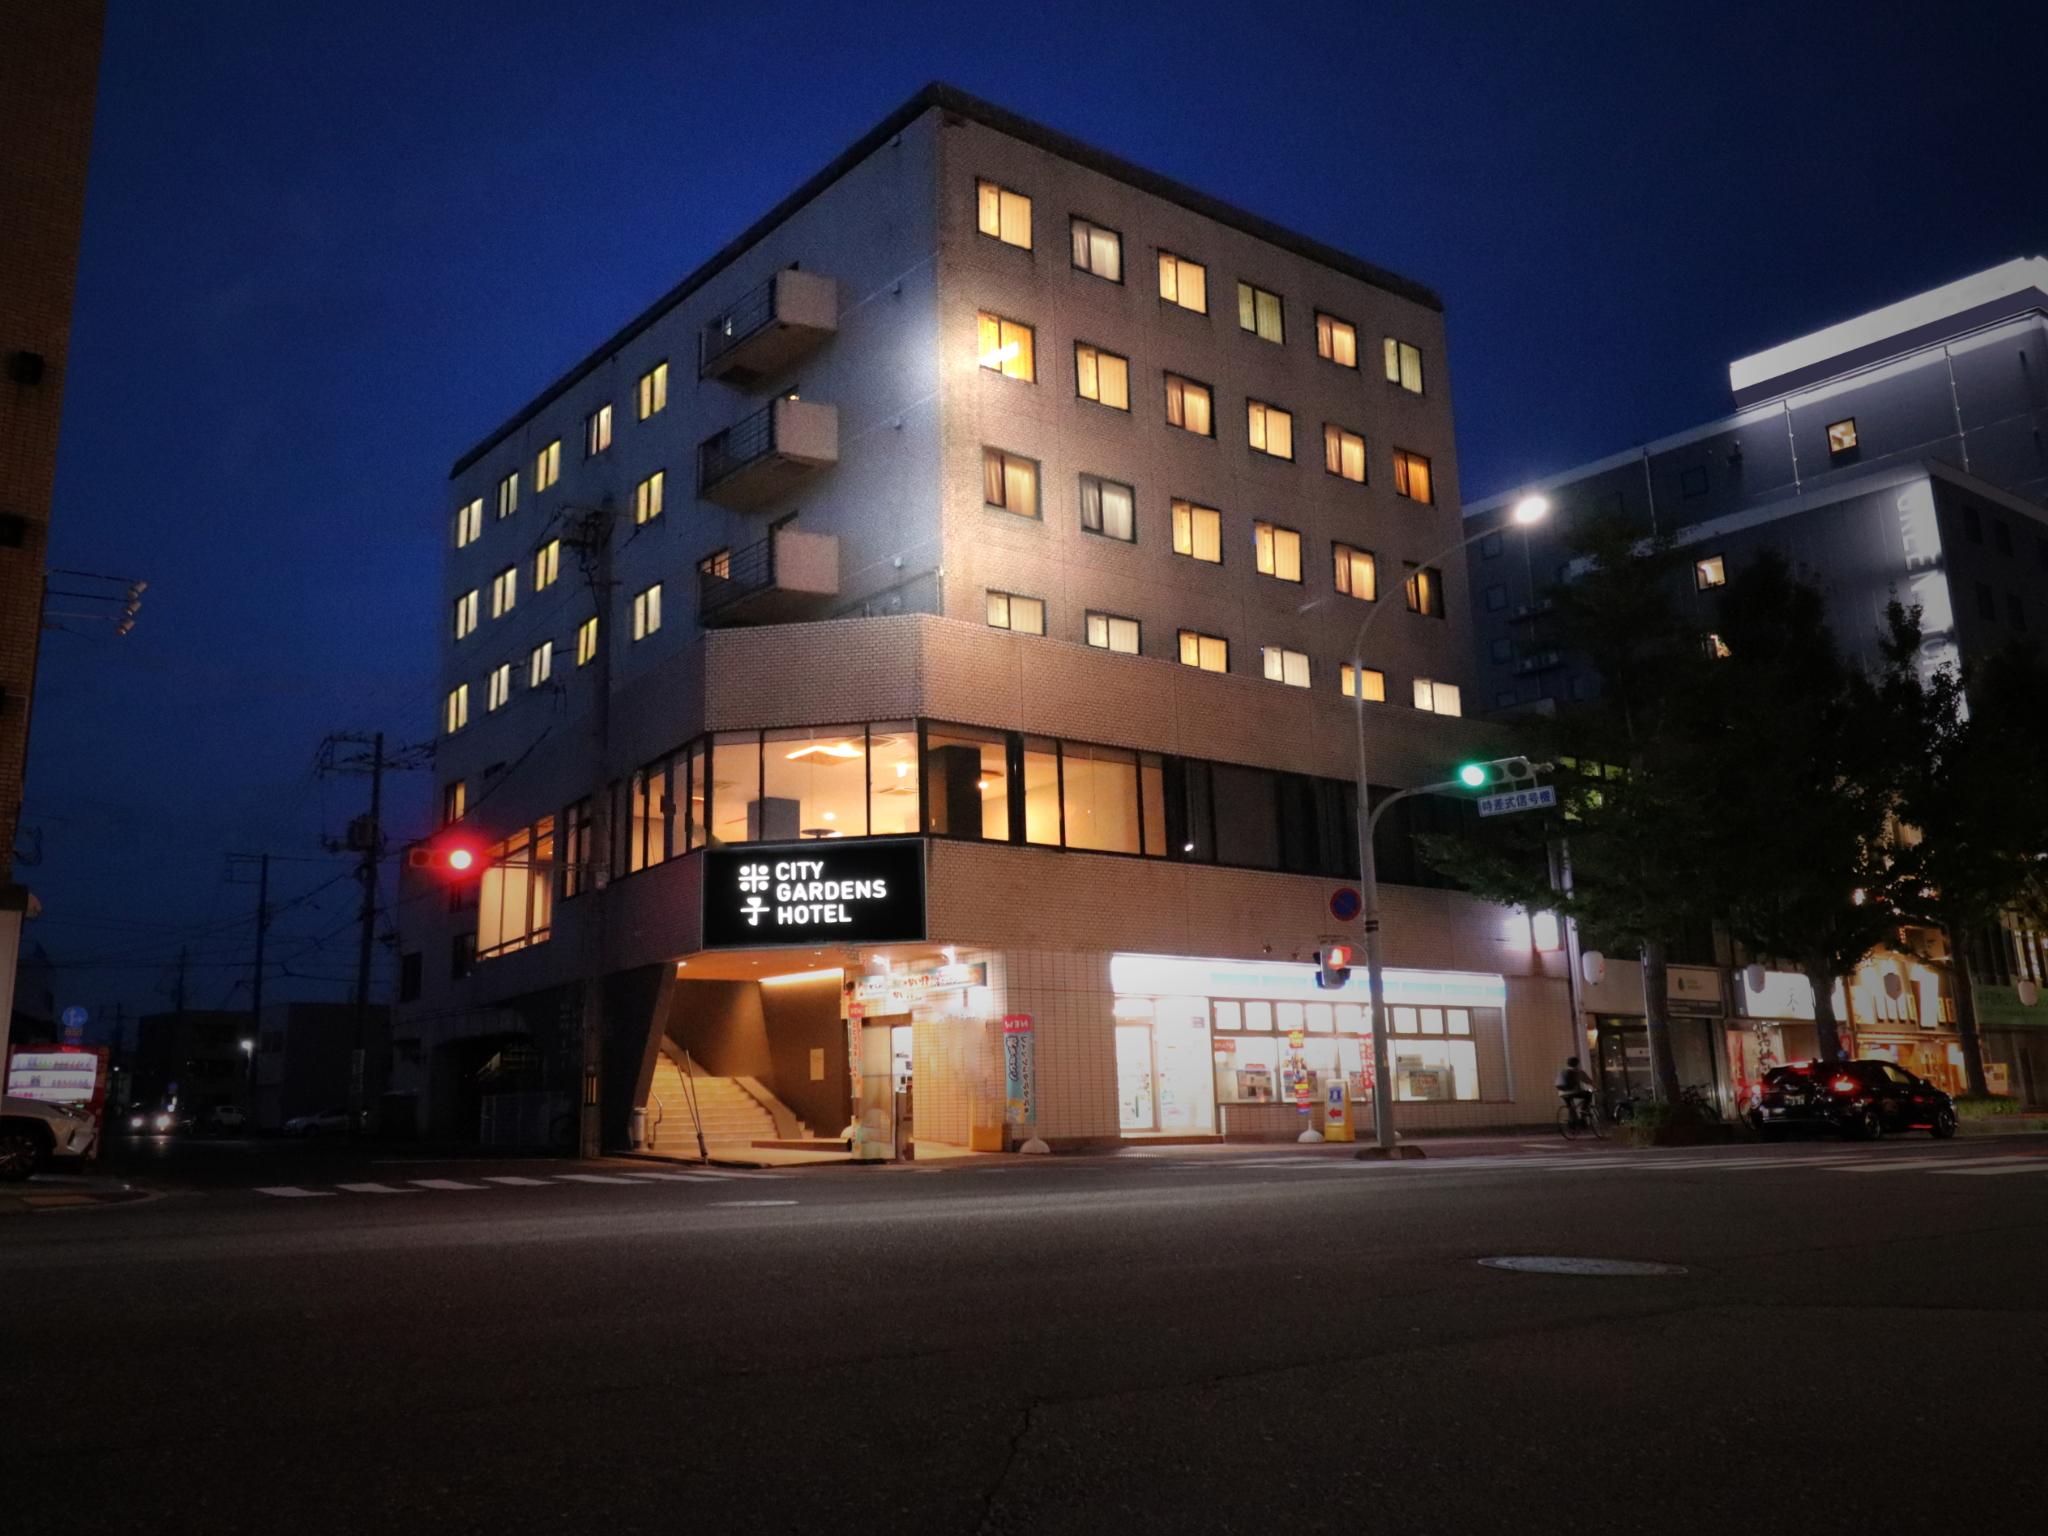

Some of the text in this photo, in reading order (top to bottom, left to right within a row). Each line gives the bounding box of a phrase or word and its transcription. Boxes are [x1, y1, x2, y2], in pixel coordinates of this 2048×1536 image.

[1481, 789, 1551, 811] 時差式信号機
[775, 861, 824, 881] CITY
[776, 879, 887, 902] GARDENS
[777, 904, 853, 925] HOTEL
